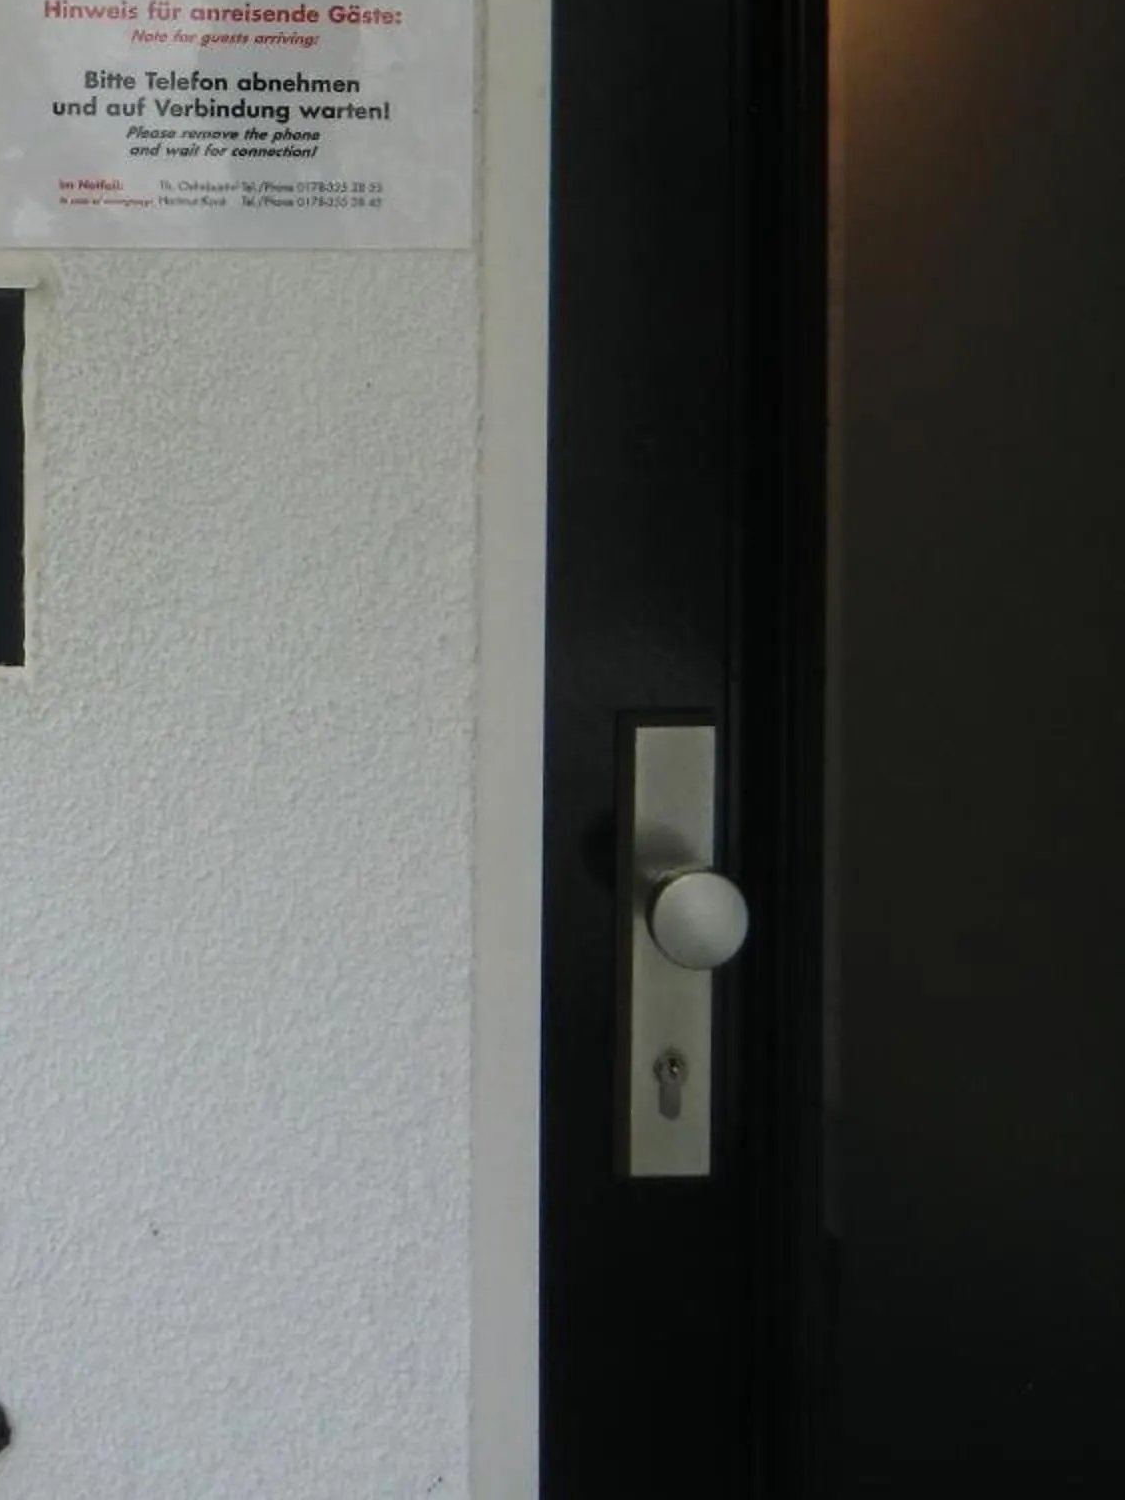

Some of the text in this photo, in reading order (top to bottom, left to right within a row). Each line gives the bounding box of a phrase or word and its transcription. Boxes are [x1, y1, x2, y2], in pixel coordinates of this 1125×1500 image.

[44, 0, 402, 24] Hinweis für anreisende Gäste:
[132, 30, 320, 47] Note for guests arriving:
[84, 70, 360, 93] Bitte Telefon abnehmen
[53, 97, 390, 123] und auf Verbindung warten!
[126, 126, 321, 143] Please remove the phone
[130, 143, 319, 158] and wait for connection!
